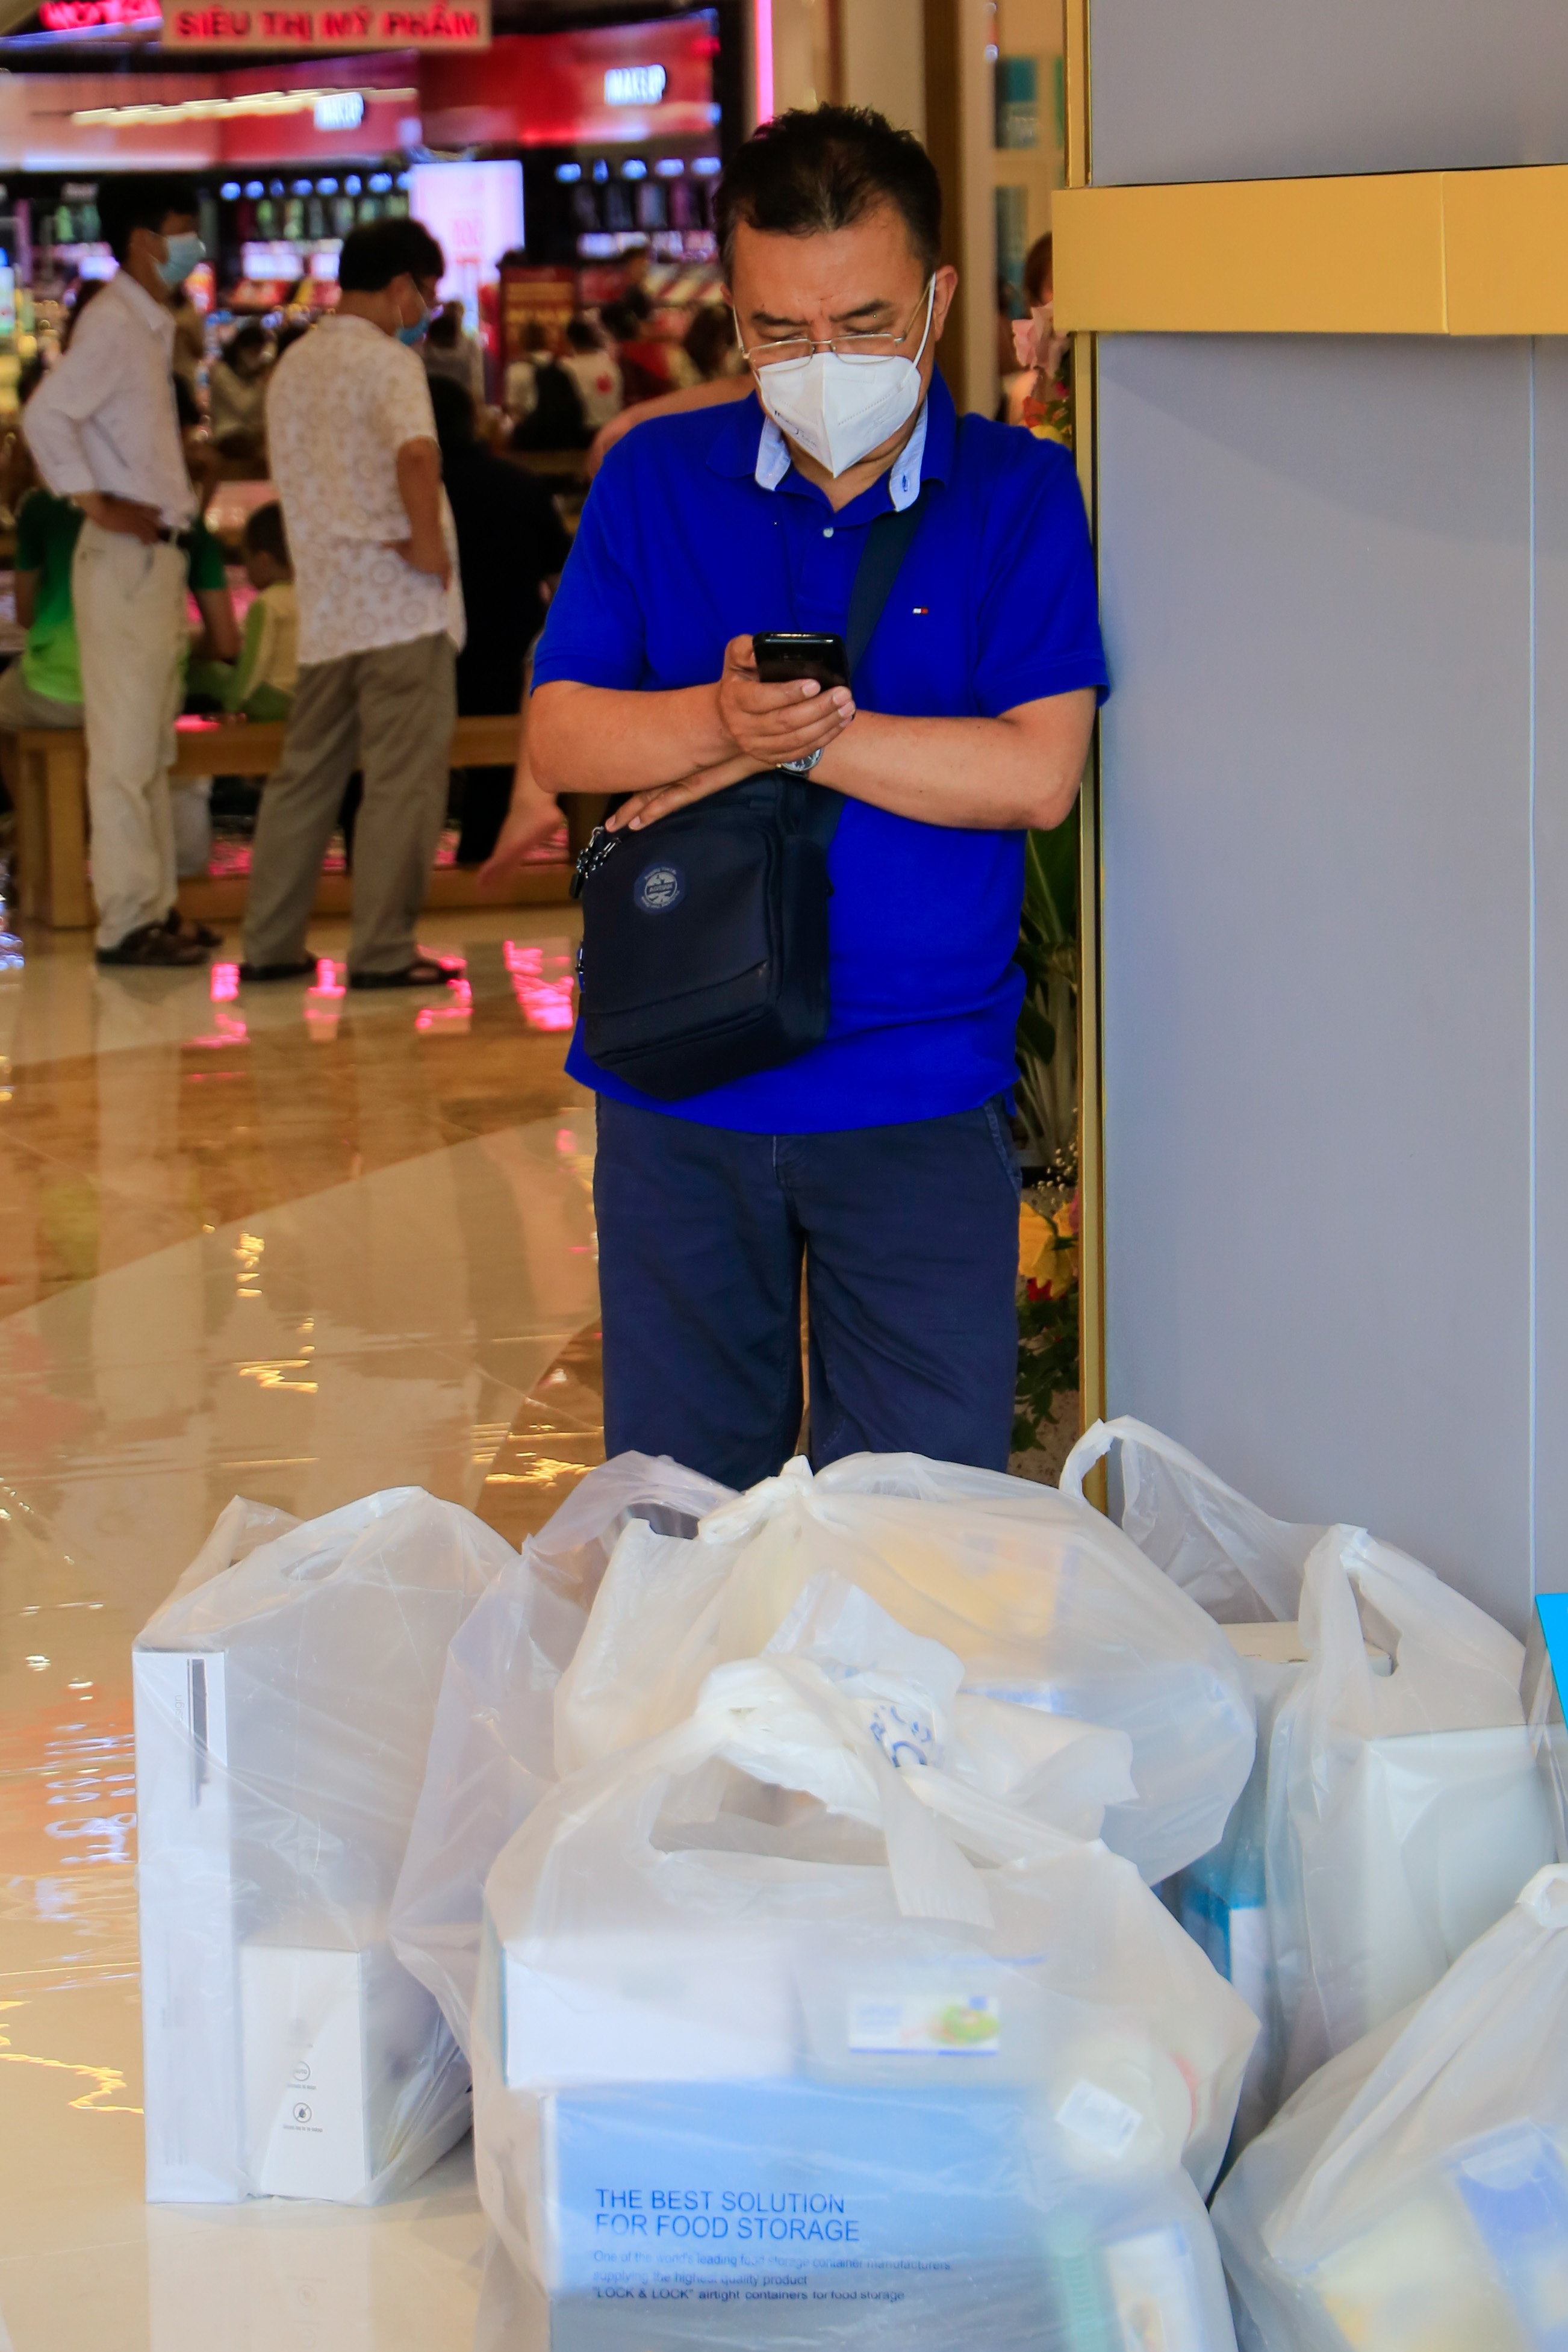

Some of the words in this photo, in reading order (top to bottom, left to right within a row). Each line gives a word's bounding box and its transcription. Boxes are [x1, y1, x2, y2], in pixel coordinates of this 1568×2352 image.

[175, 4, 250, 37] SIÊU
[260, 11, 312, 41] THỊ
[595, 2188, 643, 2209] THE
[652, 2189, 713, 2210] BEST
[721, 2191, 845, 2214] SOLUTION
[596, 2213, 648, 2236] FOR
[657, 2215, 729, 2238] FOOD
[737, 2217, 860, 2241] STORAGE
[594, 2250, 617, 2262] One
[621, 2251, 632, 2262] of
[696, 2252, 737, 2268] leading
[721, 2274, 758, 2287] quality
[762, 2274, 807, 2287] product
[638, 2288, 647, 2298] &
[698, 2290, 740, 2302] airtight
[745, 2291, 808, 2300] containers
[812, 2291, 829, 2300] for
[830, 2290, 857, 2300] food
[860, 2291, 906, 2303] storage
